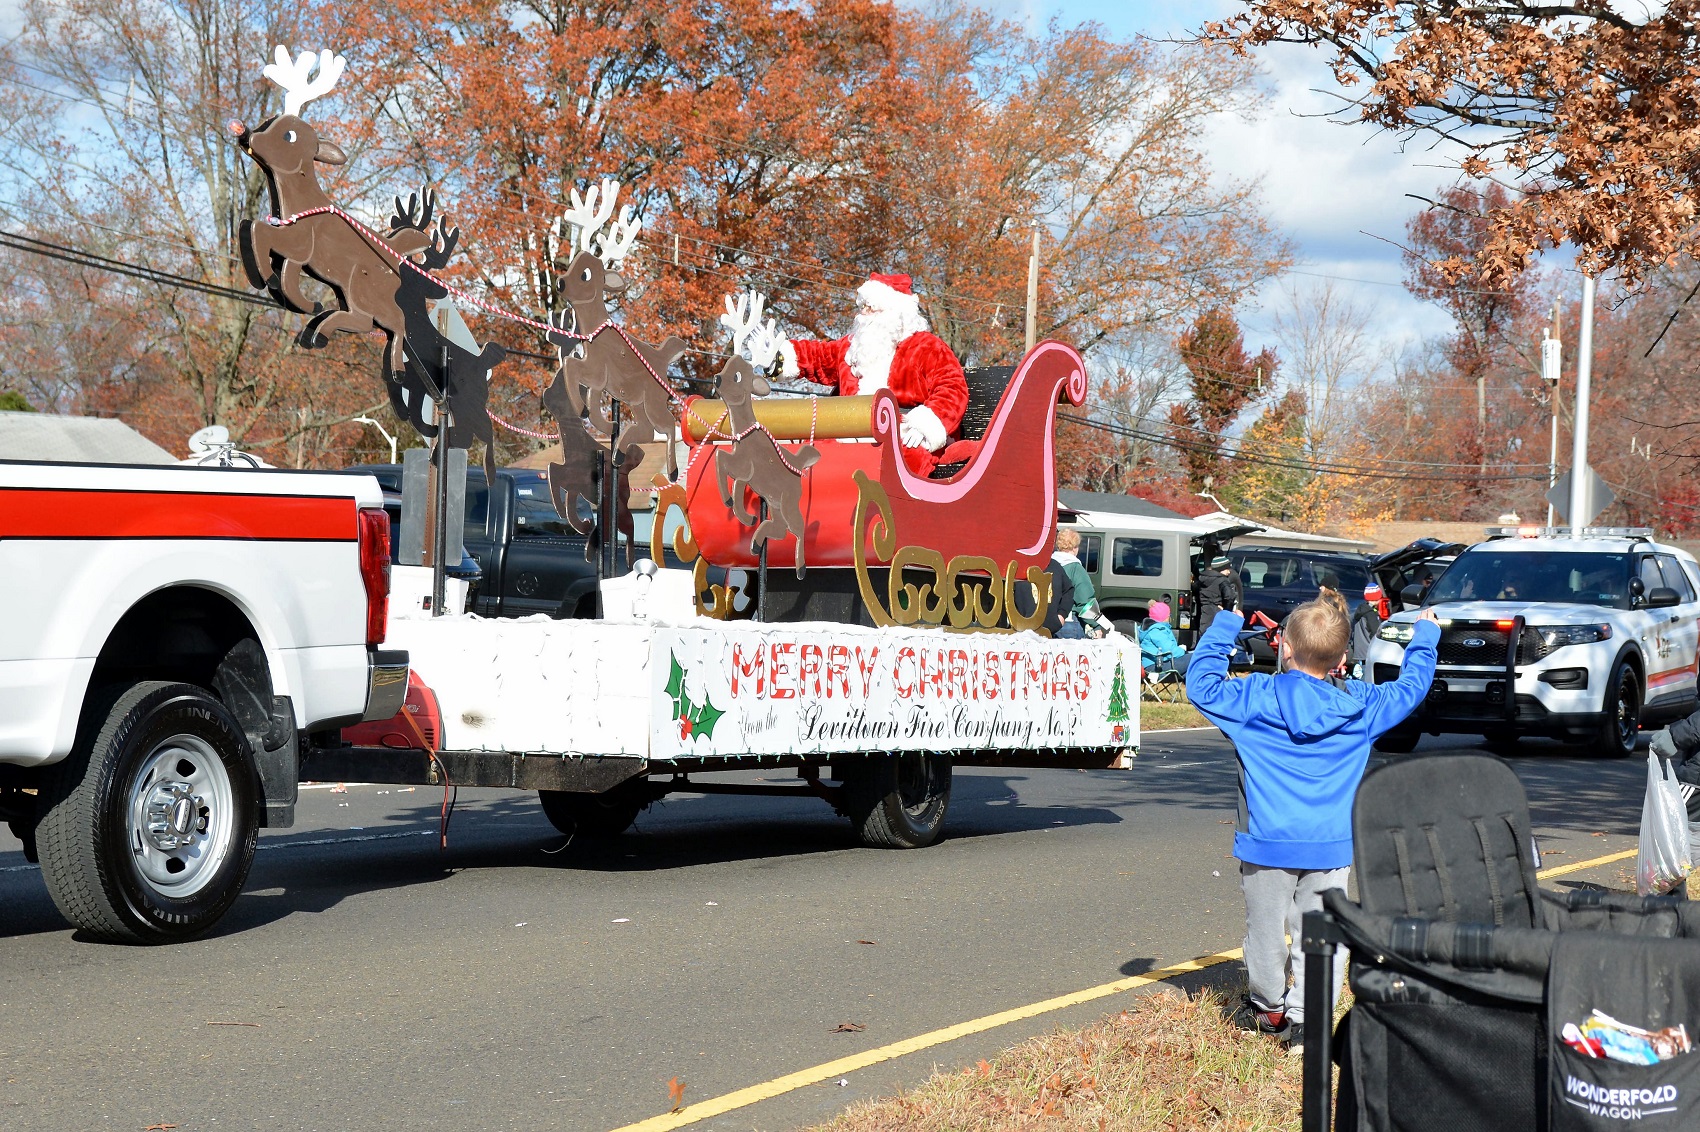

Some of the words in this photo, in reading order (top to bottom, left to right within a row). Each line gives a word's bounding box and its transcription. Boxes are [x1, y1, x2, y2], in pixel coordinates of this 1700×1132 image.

[731, 642, 879, 699] MERRY
[893, 647, 1091, 700] CHRISTMAS
[765, 705, 778, 732] the
[801, 704, 900, 740] Levittown
[904, 704, 945, 739] Fire
[952, 704, 1033, 747] Company
[1036, 705, 1064, 737] No.
[1566, 1074, 1677, 1106] WONDERFOLD
[1589, 1102, 1642, 1120] WAGON
